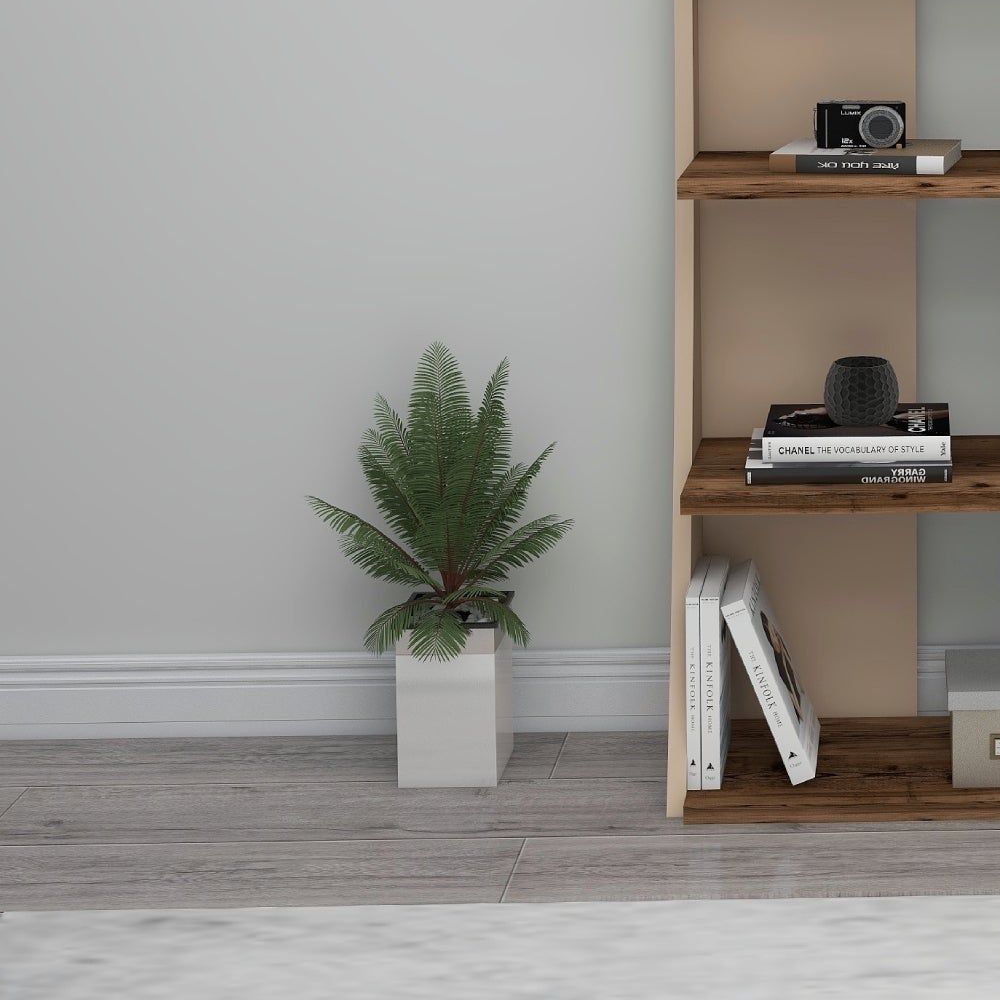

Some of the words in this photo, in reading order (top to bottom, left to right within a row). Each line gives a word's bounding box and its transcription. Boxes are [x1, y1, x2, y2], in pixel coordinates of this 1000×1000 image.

[907, 406, 925, 433] CHANEL
[834, 446, 886, 454] VOCABULARY
[753, 664, 777, 710] KINFOLK
